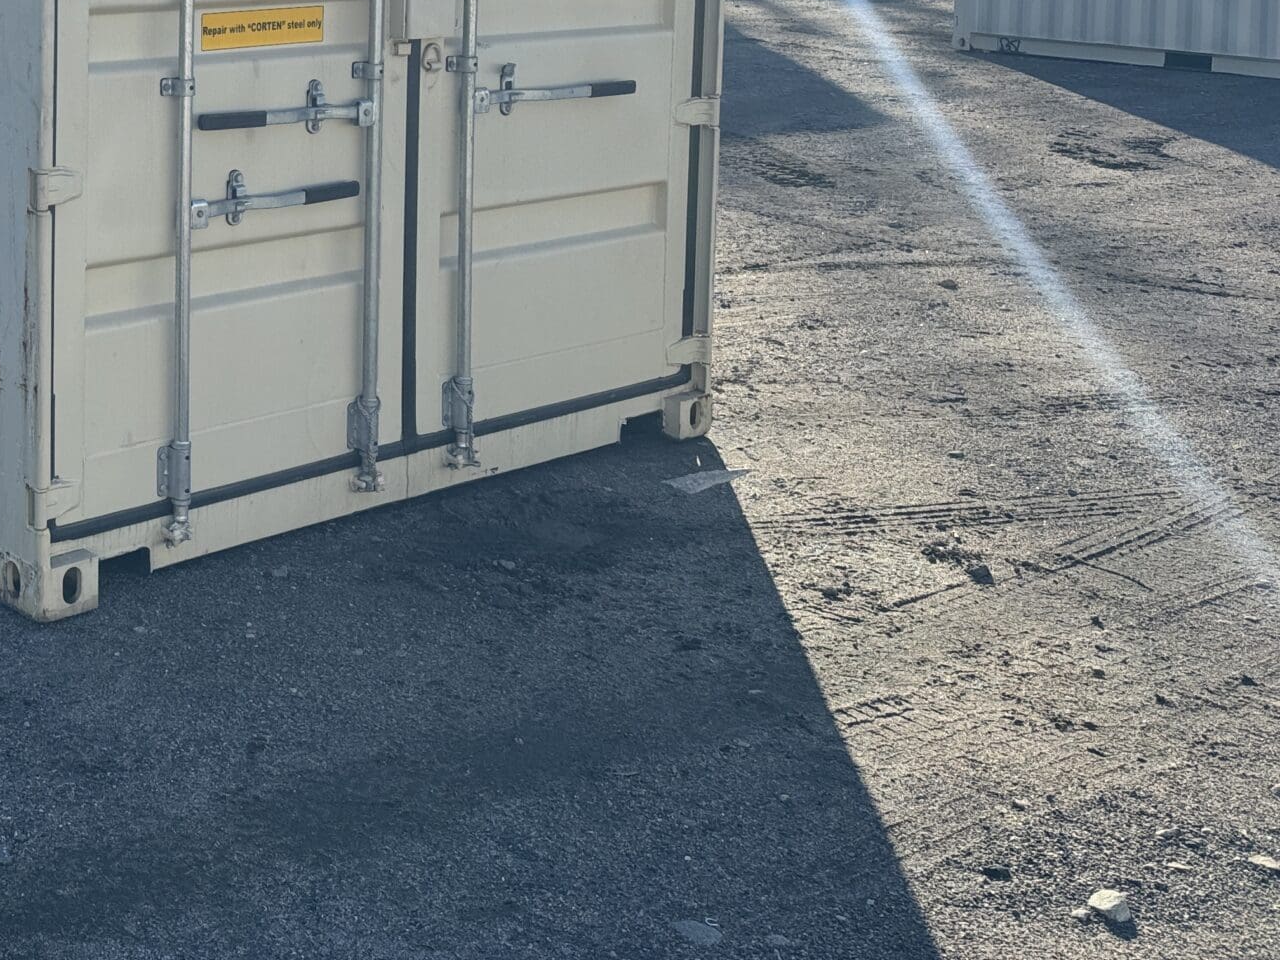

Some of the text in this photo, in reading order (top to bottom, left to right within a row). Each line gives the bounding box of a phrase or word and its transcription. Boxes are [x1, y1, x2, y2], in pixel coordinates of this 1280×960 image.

[202, 25, 227, 38] Repair
[229, 23, 245, 33] with
[287, 19, 305, 30] steel
[306, 18, 322, 30] only
